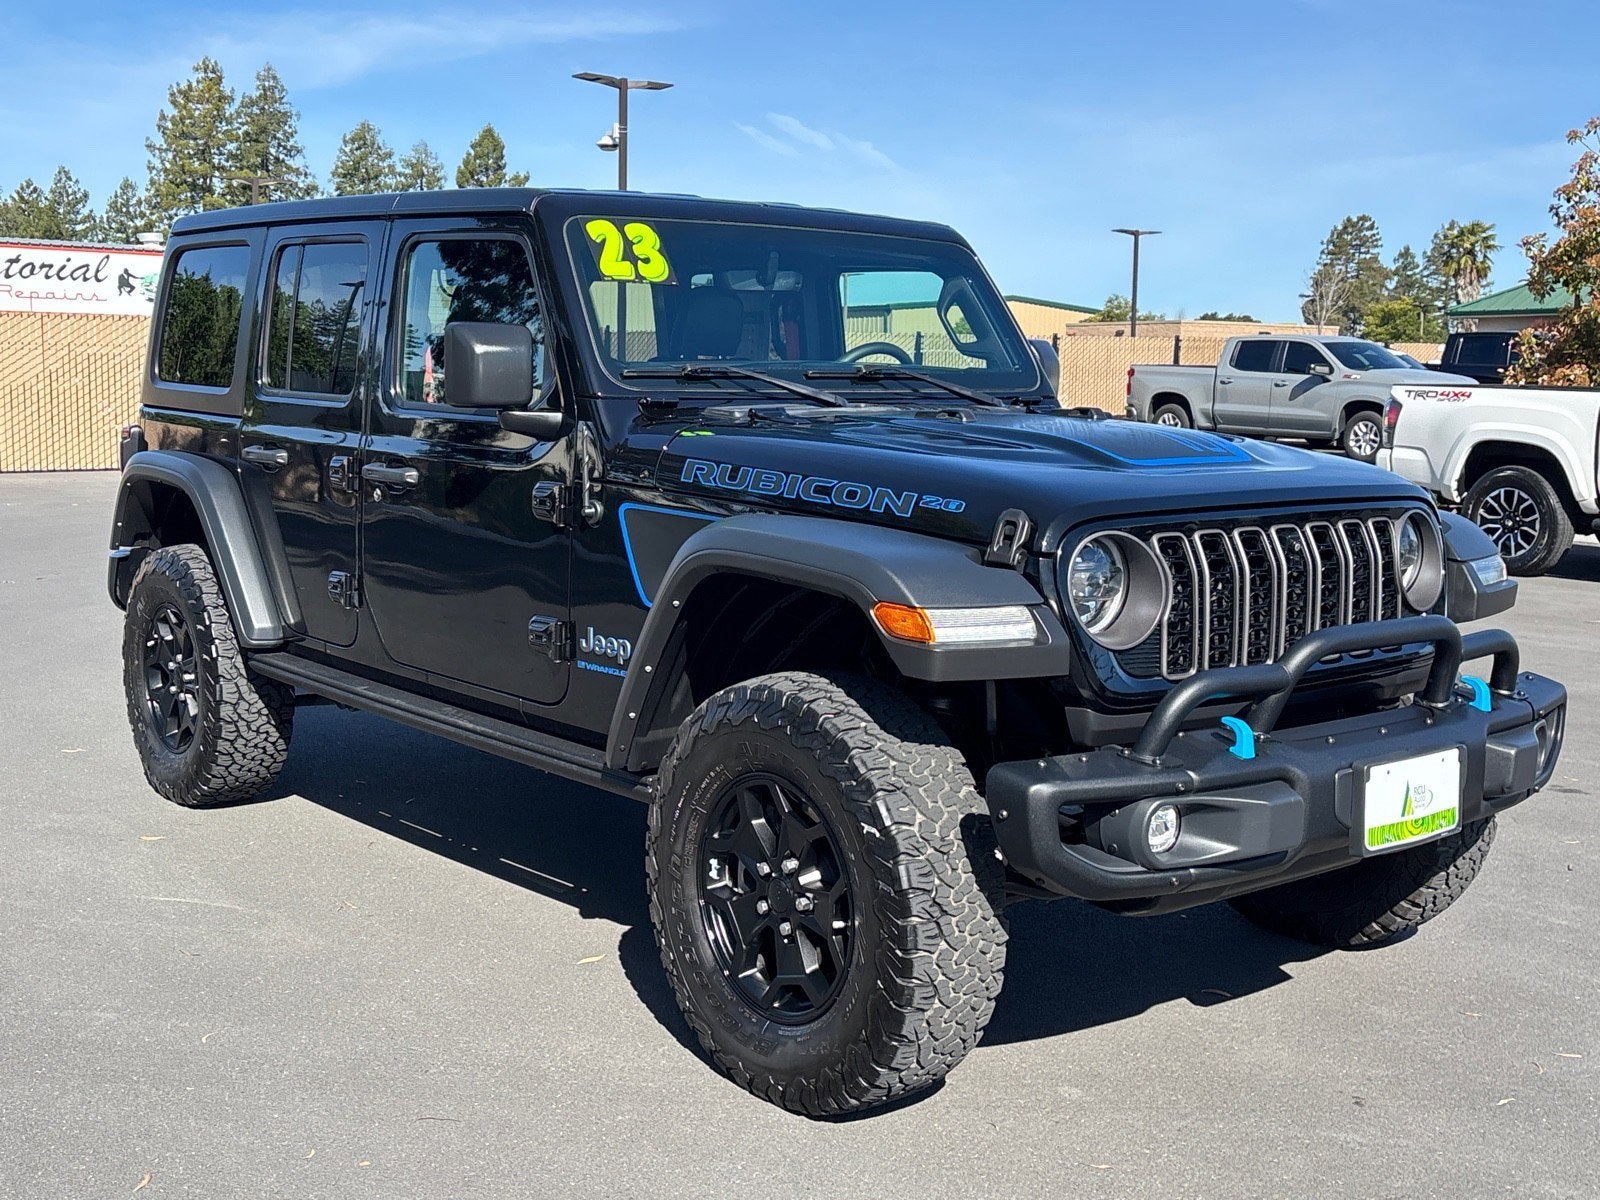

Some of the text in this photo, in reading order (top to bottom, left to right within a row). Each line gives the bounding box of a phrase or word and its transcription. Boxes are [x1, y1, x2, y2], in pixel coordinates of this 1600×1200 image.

[585, 219, 669, 282] 23
[1405, 390, 1438, 400] TRD
[681, 458, 966, 518] RUBICON 20
[579, 626, 632, 665] Jeep
[585, 661, 628, 678] WRANGLE
